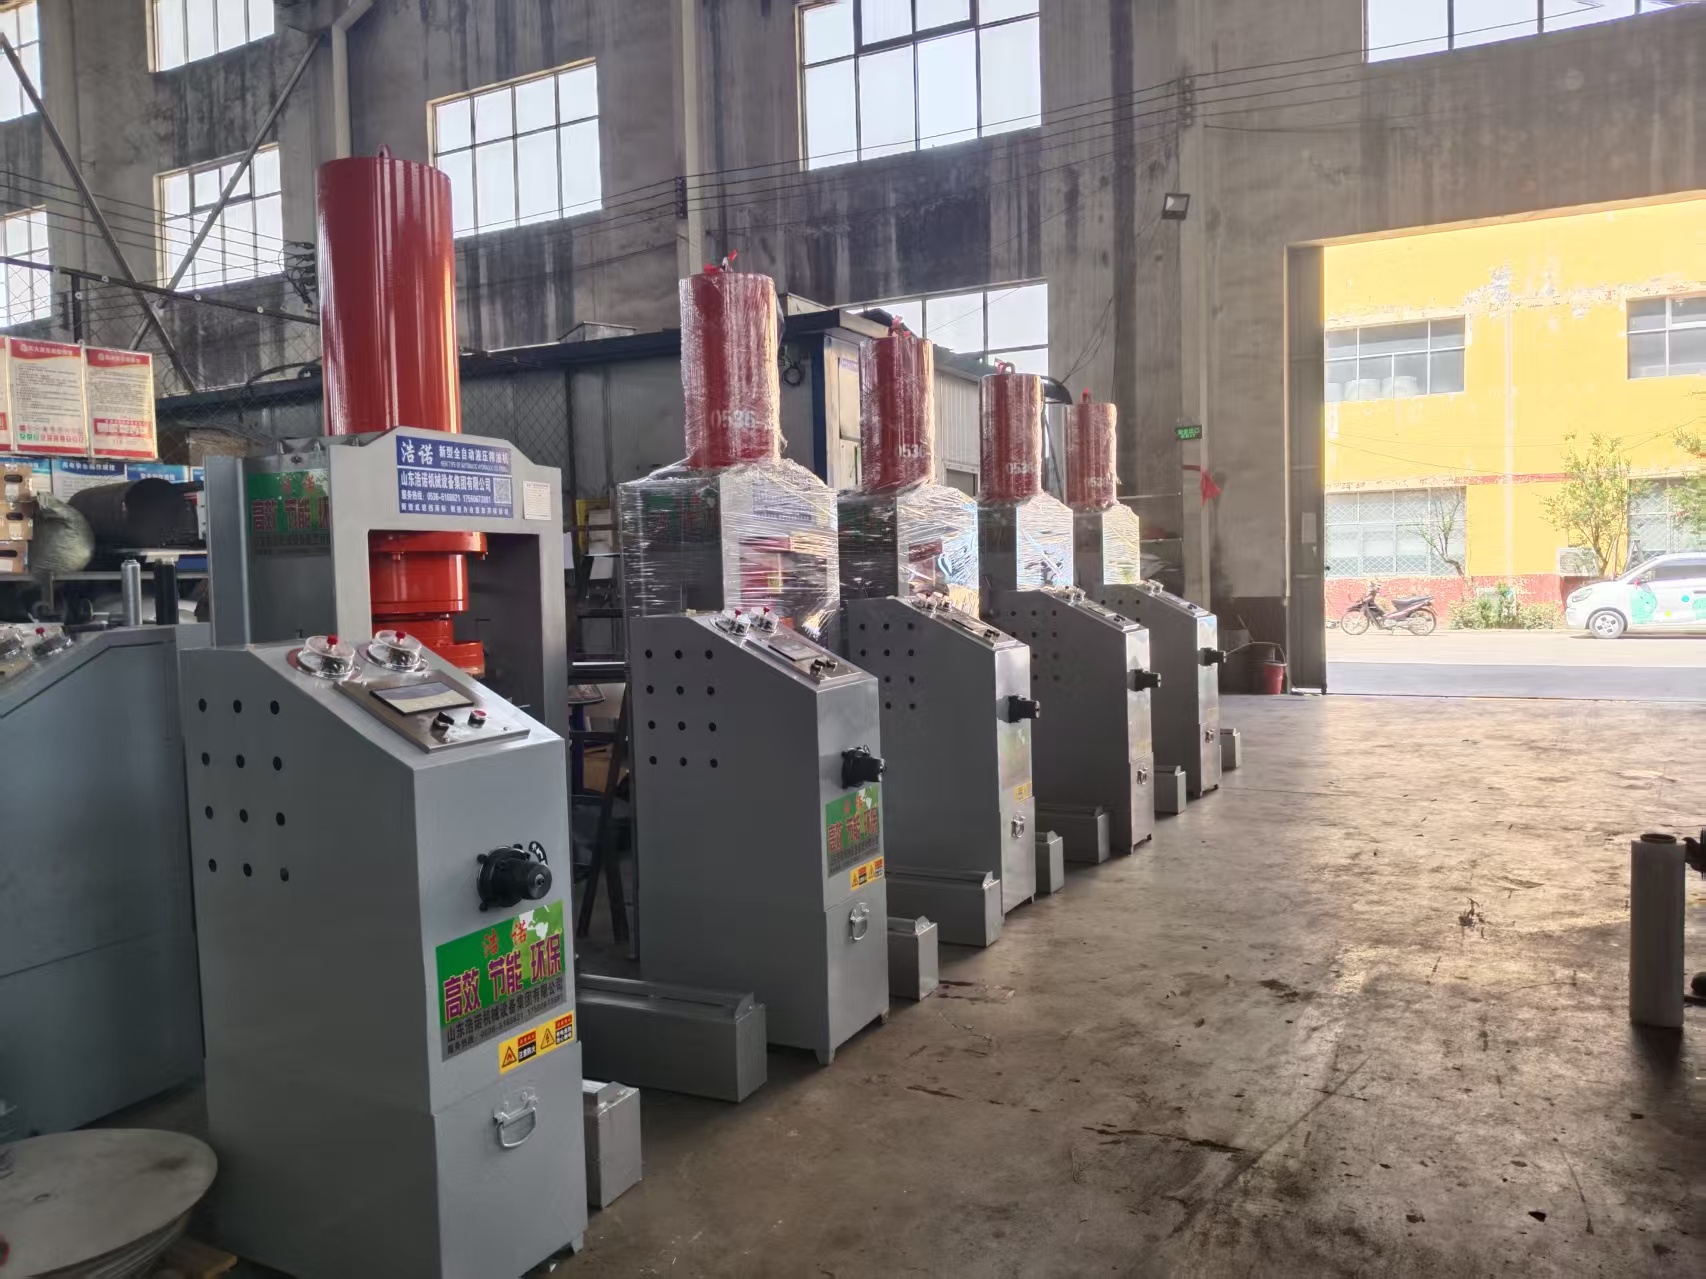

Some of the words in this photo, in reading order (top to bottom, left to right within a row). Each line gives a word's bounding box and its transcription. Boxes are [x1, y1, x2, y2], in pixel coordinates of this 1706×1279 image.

[401, 439, 433, 465] 浩诺
[482, 919, 528, 958] 浩诺
[443, 966, 481, 1023] 高效
[488, 949, 524, 1001] 节能
[530, 933, 562, 983] 环保
